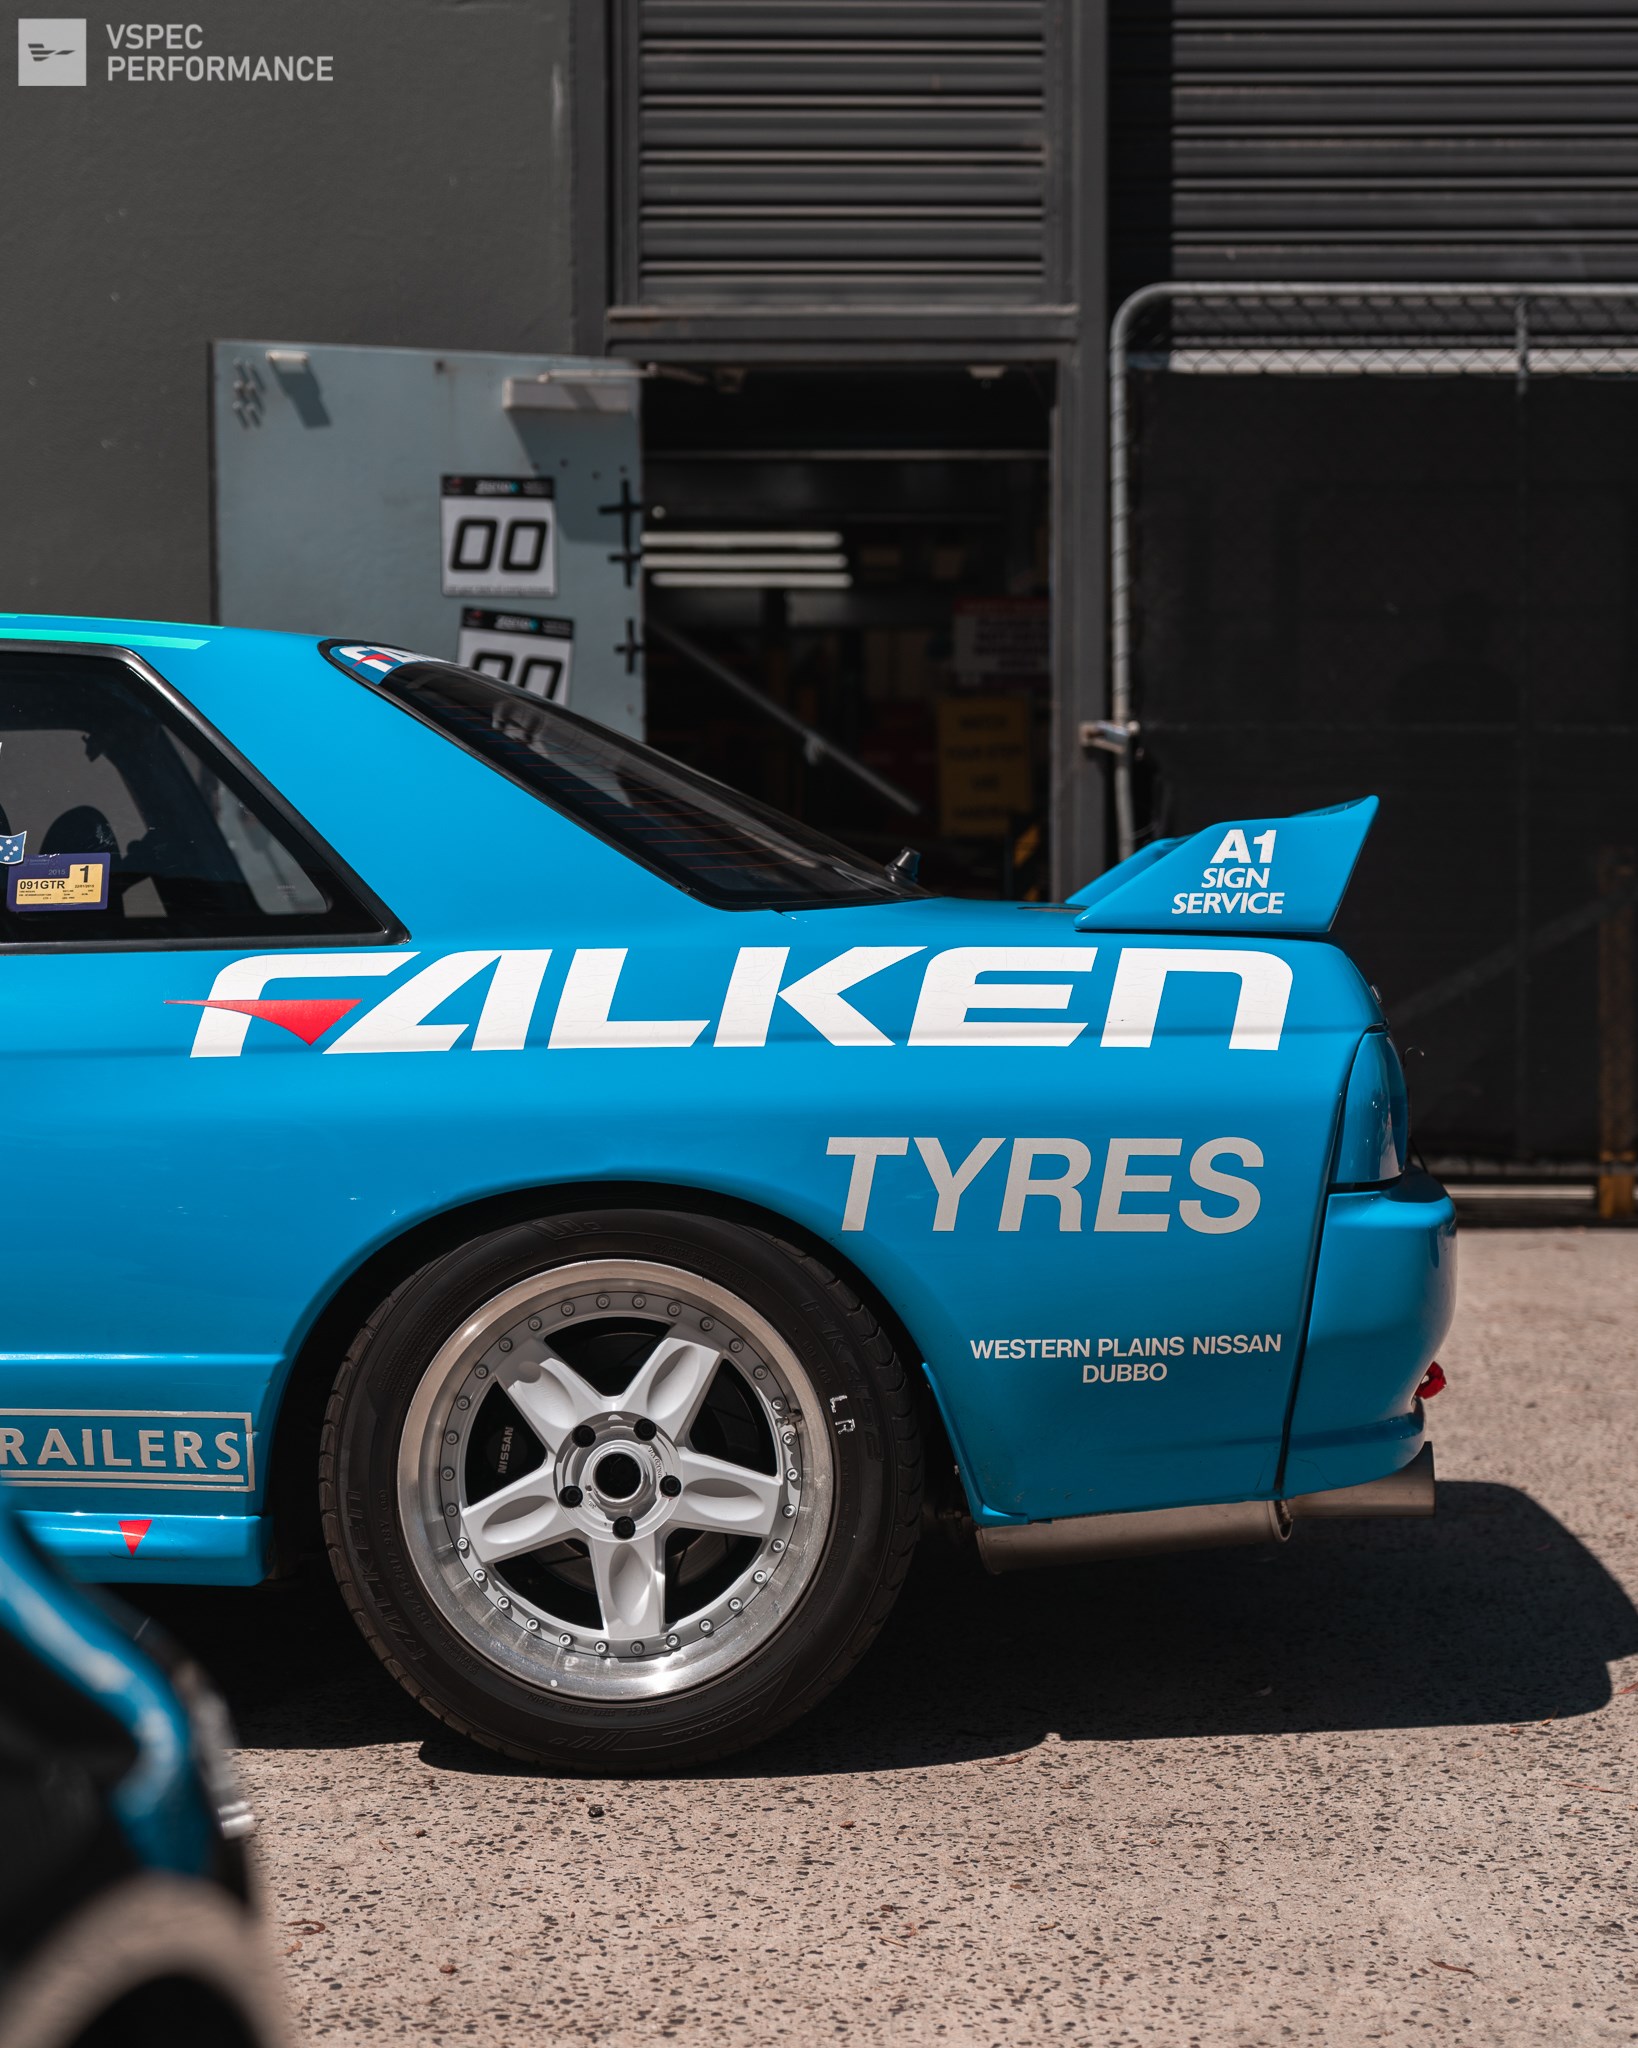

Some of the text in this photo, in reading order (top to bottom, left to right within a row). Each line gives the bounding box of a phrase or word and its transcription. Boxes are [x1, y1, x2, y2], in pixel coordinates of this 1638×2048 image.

[450, 517, 548, 572] 00
[1210, 829, 1277, 864] A1
[20, 880, 65, 889] 091GTR
[79, 865, 90, 882] 1
[1201, 867, 1270, 889] SIGN
[1171, 892, 1285, 915] SERVICE
[827, 1137, 1264, 1234] TYRES
[970, 1334, 1282, 1360] WESTERN PLAINS NISSAN
[1082, 1362, 1168, 1384] DUBBO
[0, 1427, 242, 1471] RAILERS
[498, 1426, 514, 1474] NISSAN
